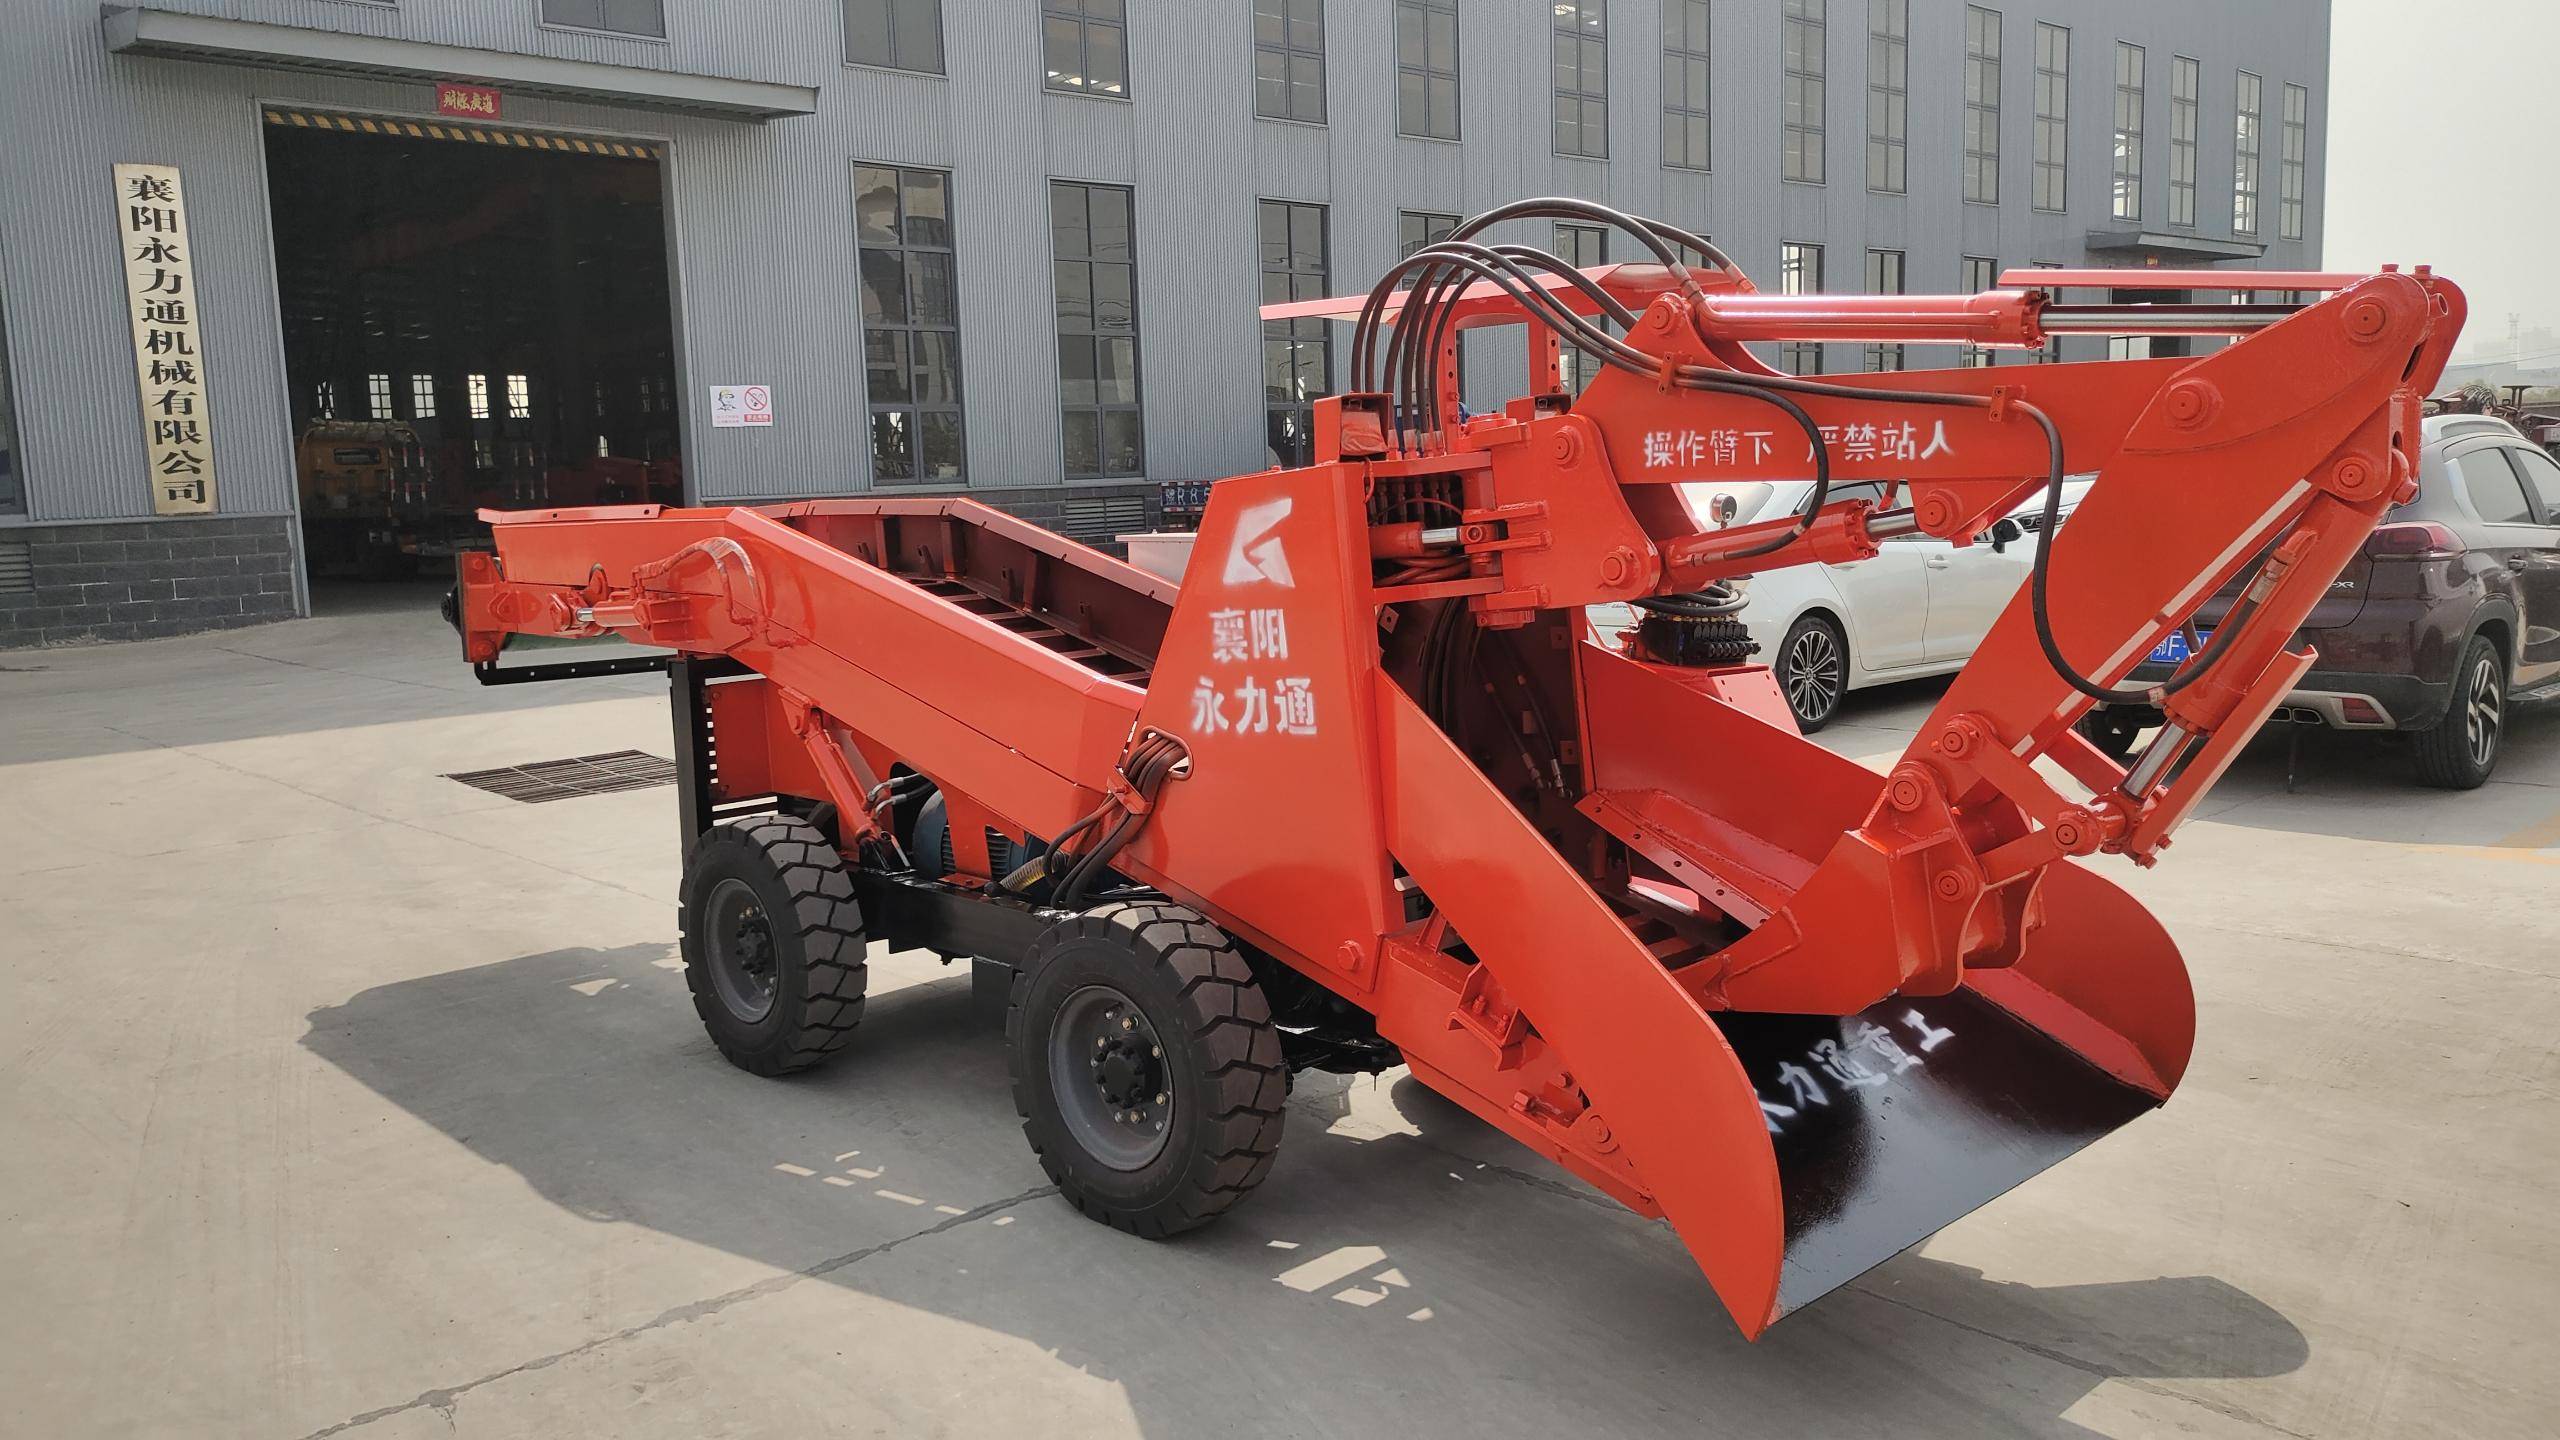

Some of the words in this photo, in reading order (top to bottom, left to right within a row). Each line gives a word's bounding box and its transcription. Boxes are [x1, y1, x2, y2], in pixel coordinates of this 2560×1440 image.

[125, 174, 206, 505] 襄阳永力通机械有限公司
[1644, 429, 1774, 468] 操作臂下
[1209, 607, 1288, 663] 襄阳
[1191, 676, 1317, 735] 永力通
